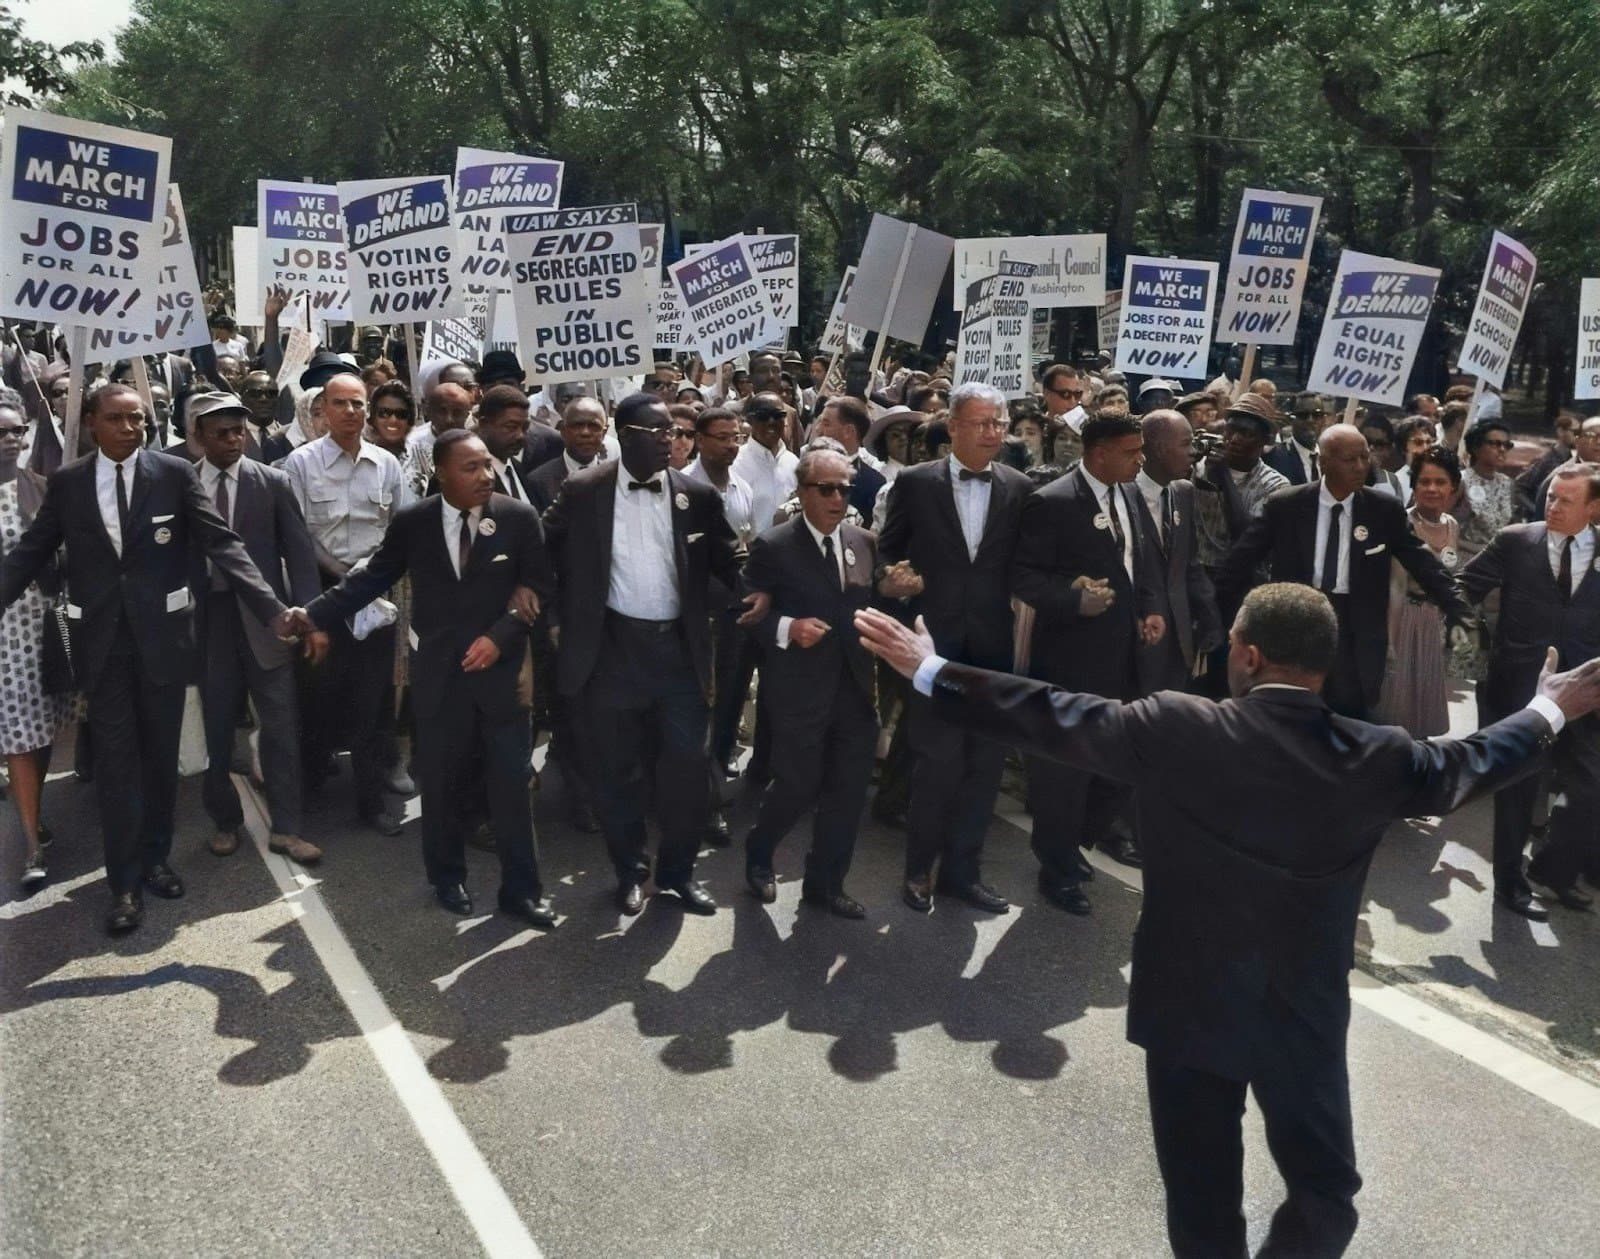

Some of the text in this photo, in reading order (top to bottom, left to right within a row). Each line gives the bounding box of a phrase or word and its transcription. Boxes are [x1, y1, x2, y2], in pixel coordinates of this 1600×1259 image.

[68, 141, 110, 166] WE
[25, 157, 145, 200] MARCH
[490, 165, 528, 185] WE
[62, 192, 108, 210] FOR
[298, 196, 325, 210] WE
[377, 188, 413, 216] WE
[462, 183, 553, 207] DEMAND
[354, 202, 445, 245] DEMAND
[459, 214, 491, 232] AN
[512, 215, 560, 232] UAW
[1271, 206, 1291, 223] WE
[20, 217, 139, 260] JOBS
[297, 230, 327, 240] FOR
[477, 235, 505, 253] LA
[532, 231, 614, 257] END
[1247, 222, 1305, 245] MARCH
[273, 248, 347, 271] JOBS
[358, 246, 451, 268] VOTING
[752, 241, 776, 258] WE
[1263, 245, 1284, 256] FOR
[22, 253, 133, 280] FOR ALL
[515, 252, 637, 284] SEGREGATED
[699, 255, 720, 273] WE
[1065, 246, 1101, 276] Council
[1511, 254, 1524, 272] WE
[275, 271, 347, 285] FOR ALL
[368, 268, 449, 289] RIGHTS
[686, 259, 744, 296] MARCH
[762, 278, 794, 290] FEPC
[1159, 269, 1182, 283] WE
[1238, 265, 1296, 290] JOBS
[1371, 274, 1411, 294] WE
[1491, 263, 1528, 296] MARCH
[15, 278, 141, 319] NOW!
[370, 285, 451, 314] NOW!
[535, 278, 622, 305] RULES
[706, 281, 730, 297] FOR
[999, 280, 1024, 297] END
[1135, 281, 1203, 300] MARCH
[1238, 292, 1289, 305] FOR ALL
[691, 284, 758, 323] INTEGRATED
[993, 299, 1029, 317] SEGREGATED
[1154, 299, 1180, 308] FOR
[1340, 294, 1430, 316] DEMAND
[1480, 296, 1519, 331] INTEGRATED
[564, 309, 595, 322] IN
[699, 301, 764, 339] SCHOOLS
[1125, 313, 1205, 329] JOBS FOR ALL
[1228, 310, 1291, 334] NOW!
[535, 320, 634, 348] PUBLIC
[711, 316, 766, 358] NOW!
[997, 320, 1022, 337] RULES
[1122, 329, 1204, 345] A DECENT PAY
[1341, 322, 1405, 351] EQUAL
[1474, 318, 1512, 351] SCHOOLS
[1003, 342, 1013, 352] IN
[1334, 341, 1404, 371] RIGHTS
[534, 344, 641, 374] SCHOOLS
[994, 353, 1022, 372] PUBLIC
[1127, 348, 1198, 369] NOW!
[1469, 343, 1505, 375] NOW!
[1325, 364, 1399, 395] NOW!
